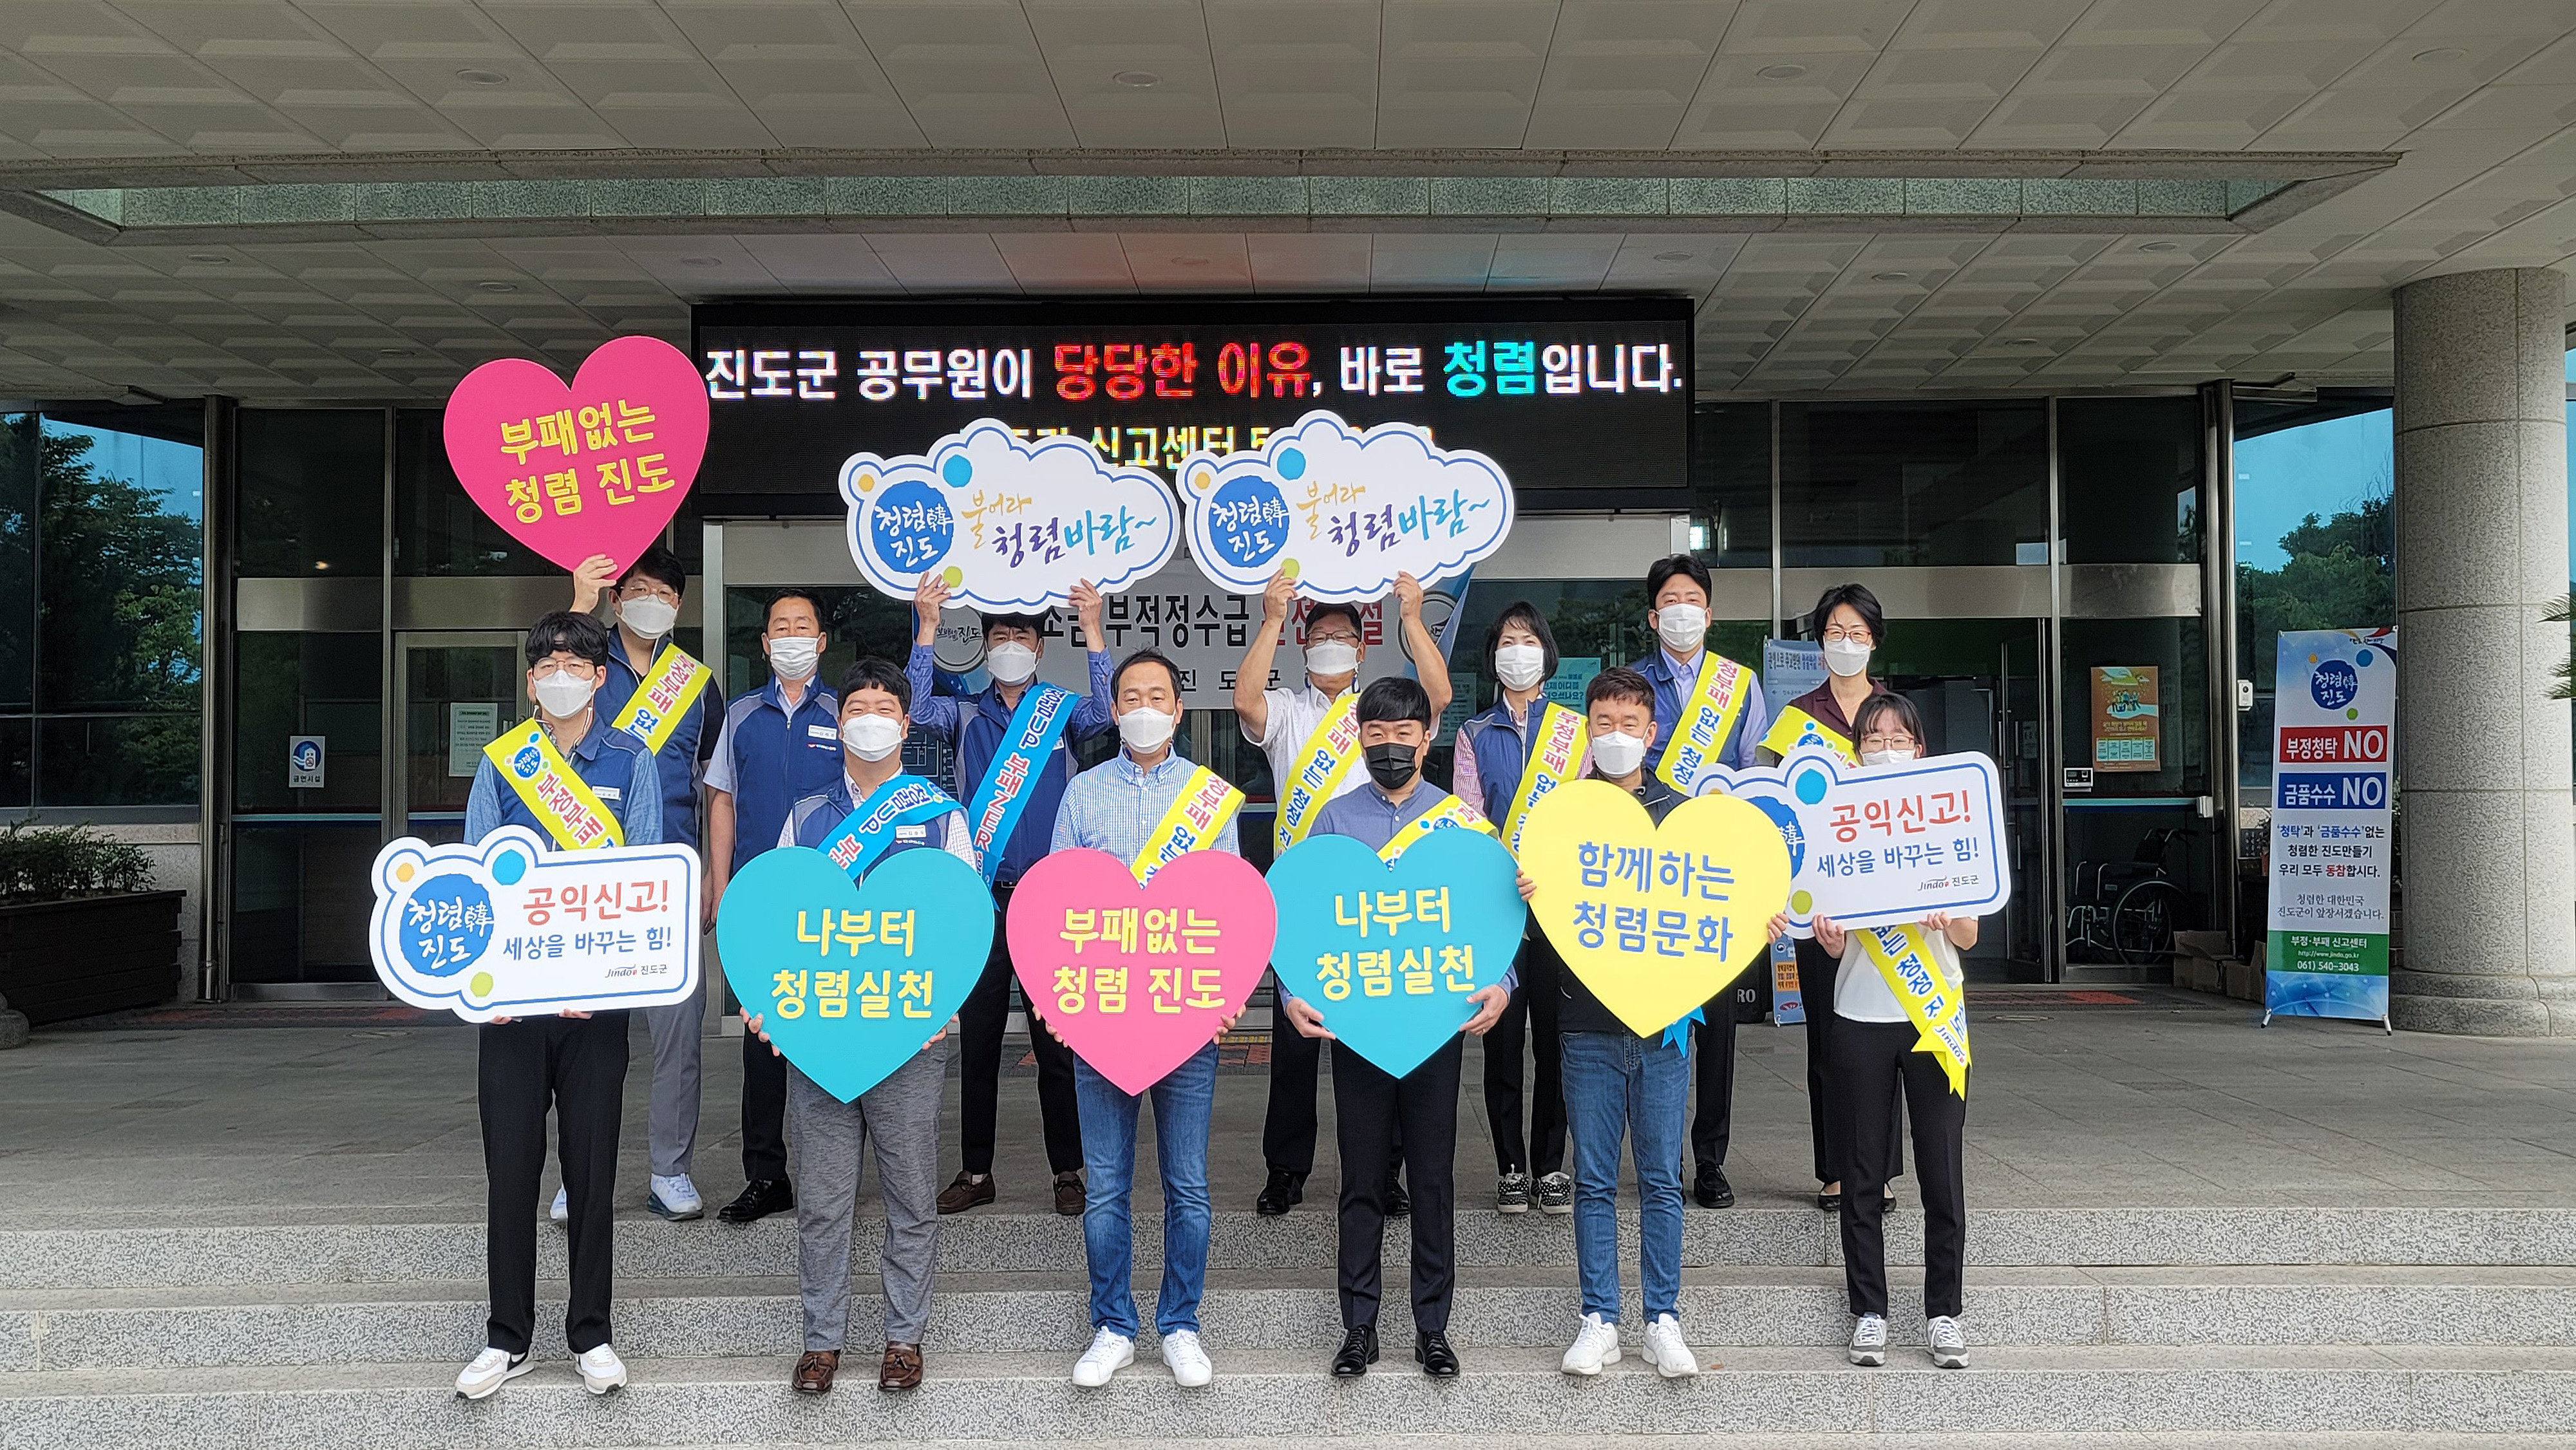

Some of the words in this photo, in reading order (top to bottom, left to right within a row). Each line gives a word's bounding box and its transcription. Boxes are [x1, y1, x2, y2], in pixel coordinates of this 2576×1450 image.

[705, 348, 837, 400] 진도군
[857, 347, 1031, 400] 공무원이
[1054, 342, 1197, 400] 당당한
[1218, 342, 1321, 398] 이유,
[1340, 346, 1423, 396] 바로
[1443, 341, 1682, 397] 청렴입니다.
[500, 400, 656, 465] 부패없는
[505, 468, 582, 523] 청렴
[596, 453, 675, 505] 진도
[961, 493, 1032, 549] 불어라
[1296, 482, 1366, 541] 불어라
[891, 538, 938, 567] 진도
[1227, 529, 1275, 562] 진도
[1104, 594, 1249, 648] 부적정수급
[649, 655, 695, 713] 부정부패
[2321, 690, 2346, 706] 진도
[1544, 711, 1579, 775] 부정부패
[1691, 707, 1719, 746] 없는
[2286, 738, 2338, 759] 부정청탁
[2344, 730, 2383, 759] NO
[1303, 750, 1335, 789] 없는
[1673, 746, 1702, 785] 청정
[538, 773, 603, 845] 부정부패
[1286, 787, 1310, 826] 청정
[2285, 784, 2336, 805] 금품수수
[2342, 777, 2382, 805] NO
[1830, 790, 1971, 842] 공익신고!
[1578, 841, 1734, 901] 함께하는
[1817, 849, 1875, 878] 세상을
[1884, 842, 1944, 869] 바꾸는
[1953, 837, 1979, 862] 힘!
[2278, 864, 2298, 876] 우리
[2303, 865, 2322, 877] 모두
[2325, 865, 2381, 878] 동참합시다.
[2287, 845, 2318, 858] 청렴한
[2322, 845, 2372, 858] 진도만들기
[1951, 874, 1979, 887] 진도군
[2297, 894, 2324, 905] 청렴한
[2327, 894, 2364, 907] 대한민국
[524, 879, 668, 926] 공익신고!
[1334, 886, 1450, 938] 나부터
[2277, 908, 2313, 918] 진도군이
[503, 934, 565, 961] 세상을
[575, 930, 636, 956] 바꾸는
[647, 927, 671, 948] 힘!
[797, 909, 914, 957] 나부터
[1059, 907, 1220, 954] 부패없는
[1573, 901, 1733, 962] 청렴문화
[2332, 937, 2367, 948] 신고센터
[418, 935, 471, 970] 진도
[641, 964, 667, 975] 진도군
[1316, 945, 1475, 1001] 청렴실천
[2297, 960, 2316, 971] 061)
[2318, 961, 2360, 972] 540-3043
[772, 969, 933, 1019] 청렴실천
[1052, 966, 1128, 1013] 청렴
[1148, 967, 1225, 1013] 진도
[1897, 953, 1933, 995] 청정
